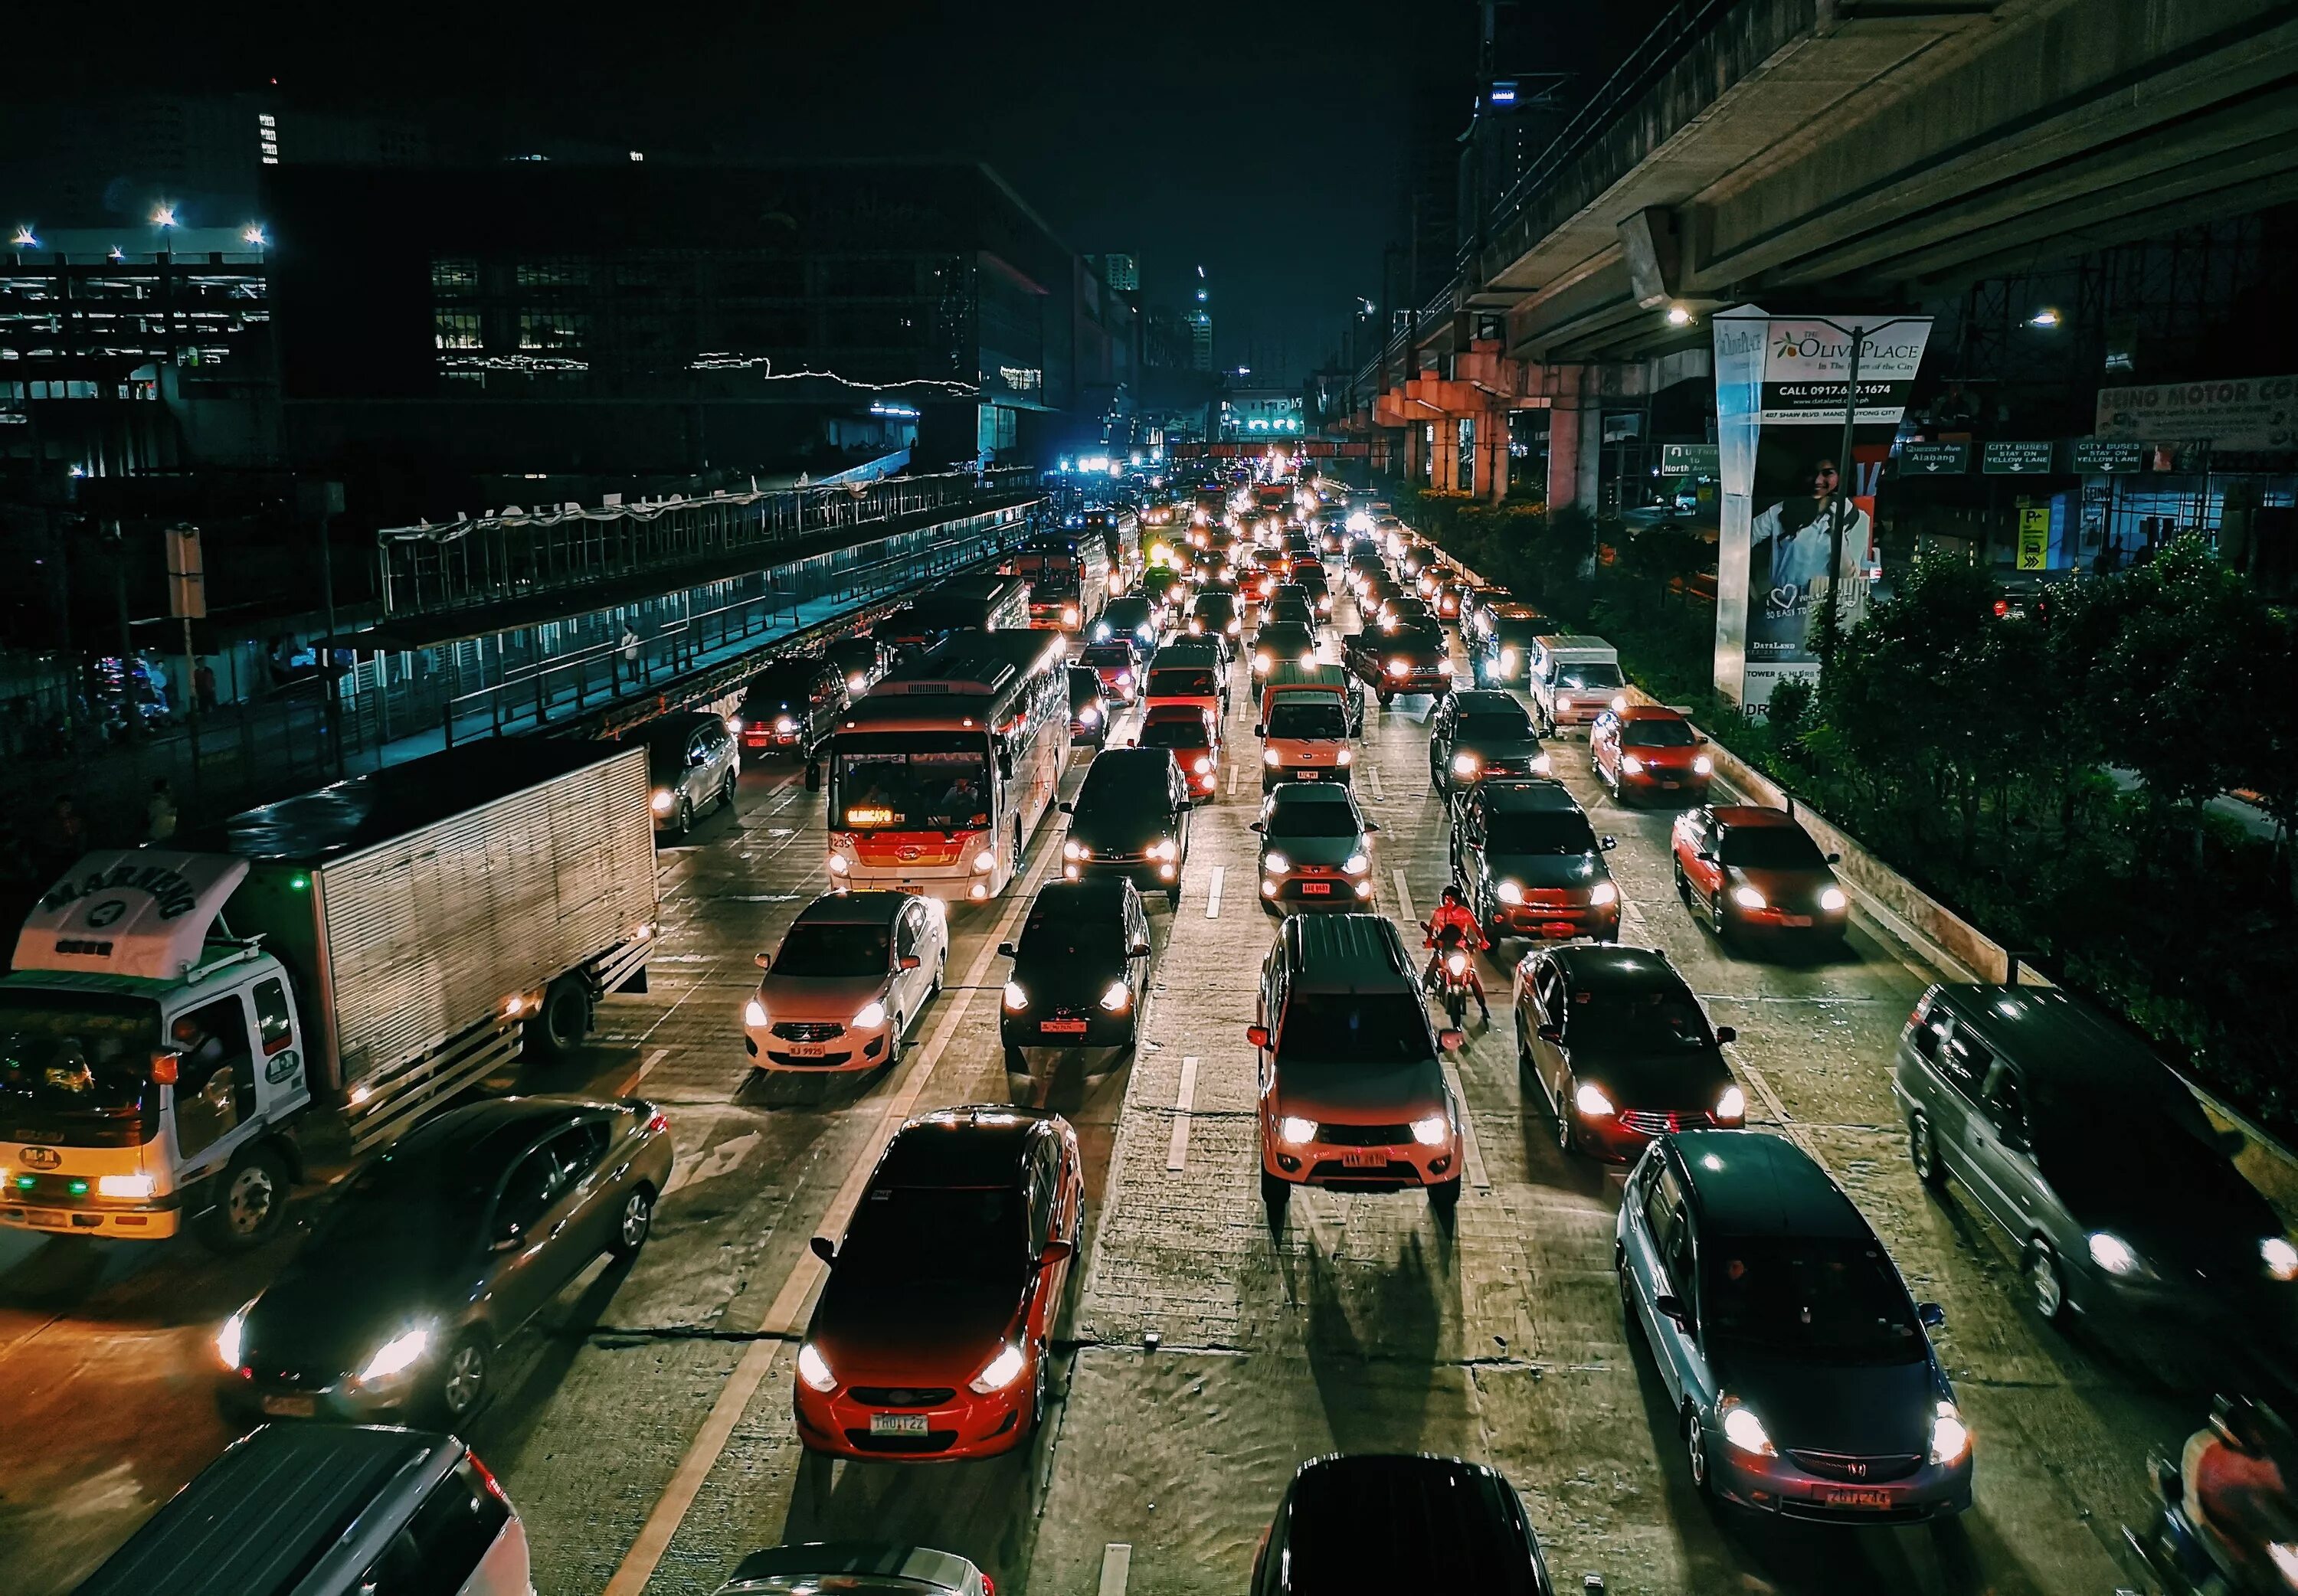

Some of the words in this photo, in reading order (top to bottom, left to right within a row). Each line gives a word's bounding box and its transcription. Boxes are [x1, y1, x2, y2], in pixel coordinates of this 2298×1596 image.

[1799, 338, 1853, 358] OLIV
[1860, 341, 1920, 358] PLACE
[1779, 386, 1808, 396] CALL
[1811, 384, 1890, 395] 0917.69.1674
[2168, 383, 2250, 405] MOTOR
[2260, 379, 2298, 401] CO
[1793, 397, 1869, 405] www.dataland.c.ph
[1944, 444, 1962, 453] Ave
[1911, 453, 1956, 464] Alabang
[1986, 456, 2022, 464] YELLOW
[2077, 456, 2112, 464] YELLOW
[1665, 464, 1690, 473] North
[2026, 510, 2036, 523] P
[1766, 610, 1775, 620] SO
[1777, 607, 1796, 618] EASY
[1797, 606, 1807, 615] TO
